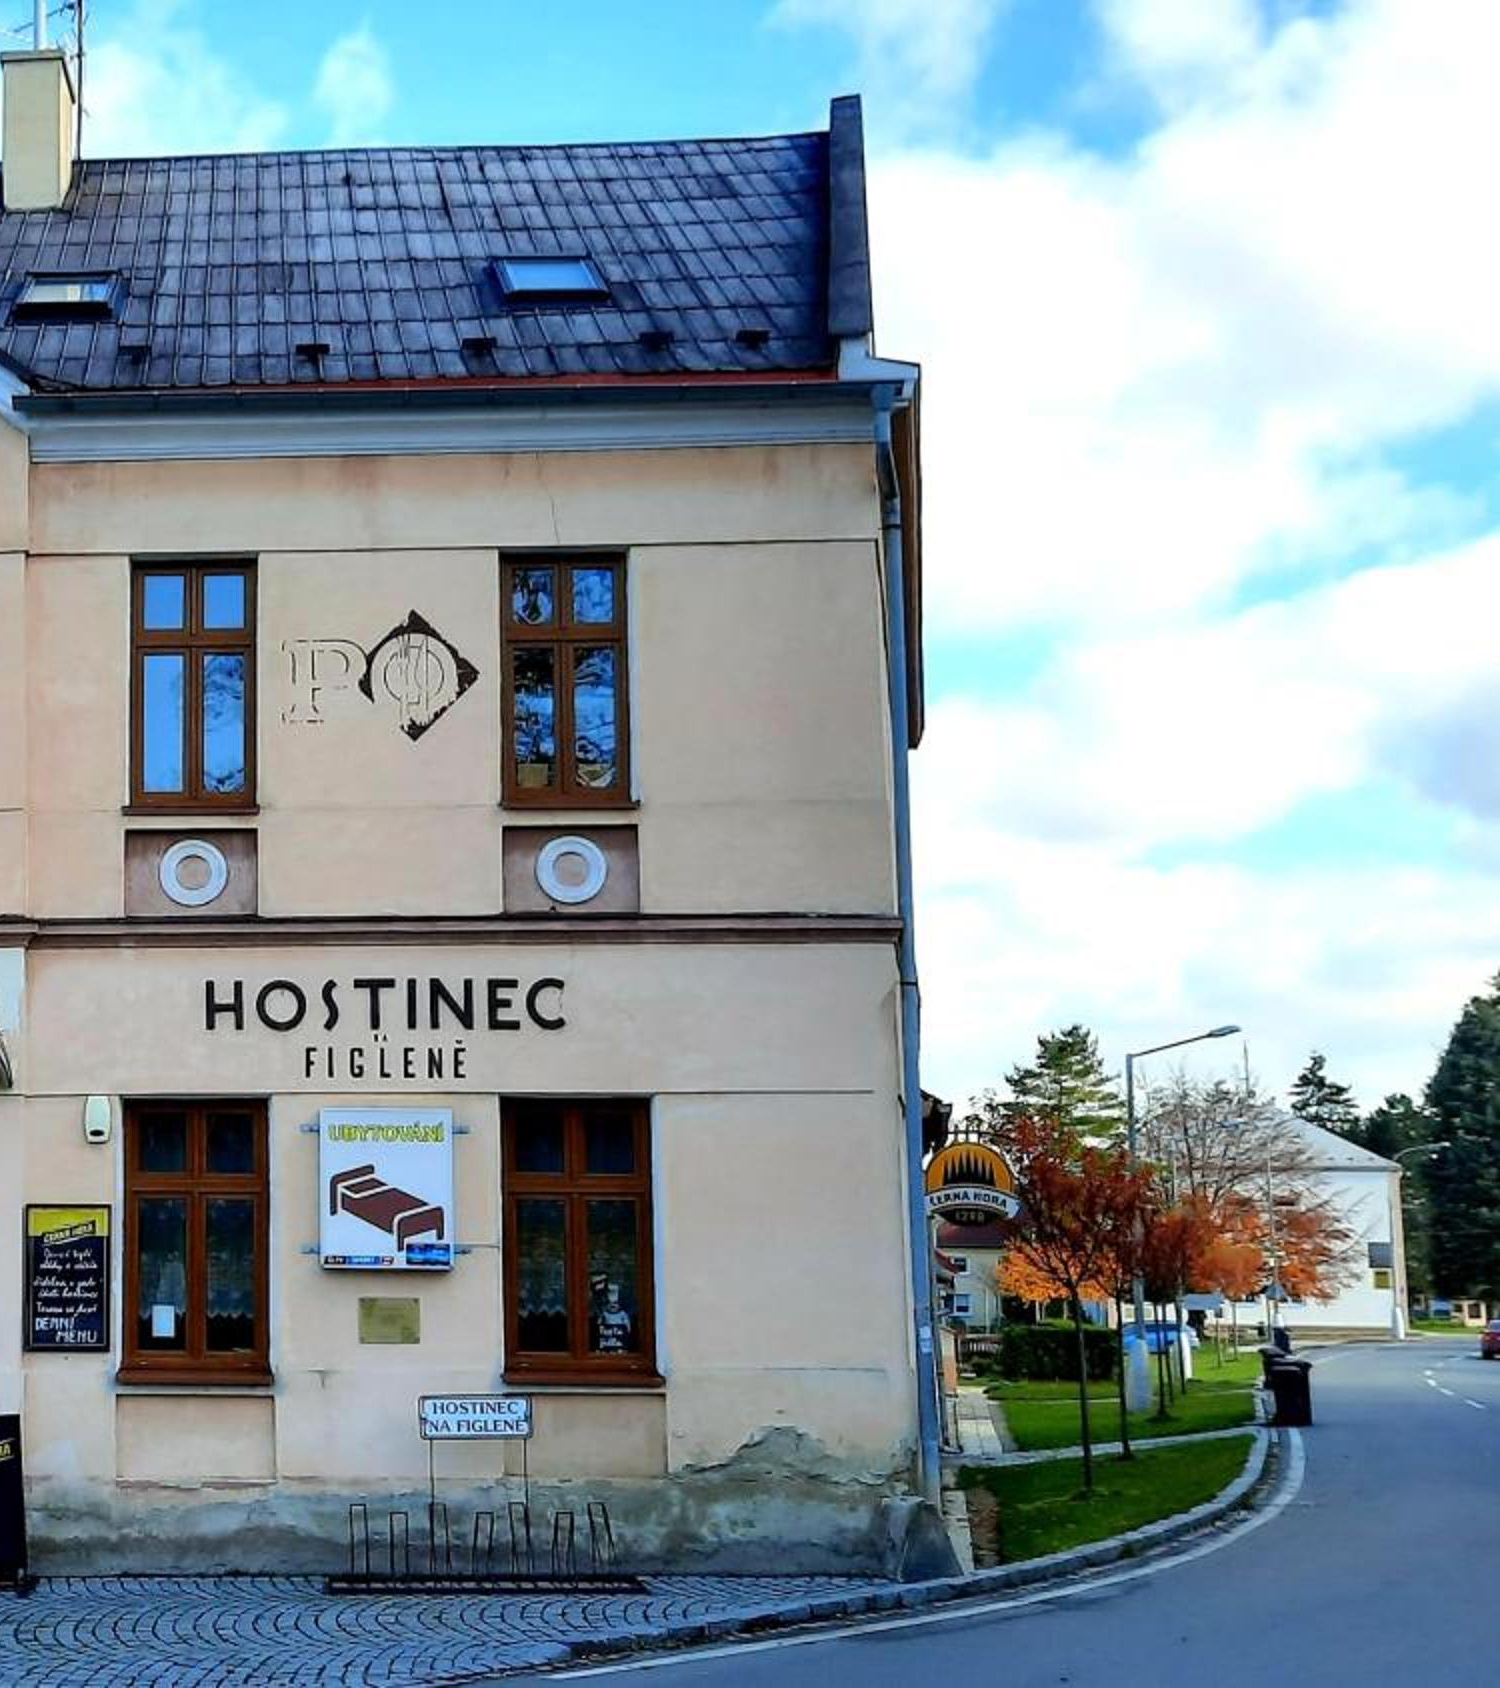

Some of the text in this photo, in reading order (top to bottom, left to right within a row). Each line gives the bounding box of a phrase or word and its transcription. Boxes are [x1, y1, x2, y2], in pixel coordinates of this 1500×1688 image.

[204, 977, 566, 1032] HOSTINEC
[304, 1039, 467, 1079] FIGLENĚ
[328, 1122, 445, 1143] UBYTOVÁNÍ
[973, 1191, 1007, 1209] HORA
[55, 1330, 98, 1343] MENU
[432, 1401, 519, 1415] HOSTINEC
[429, 1419, 451, 1432] NA
